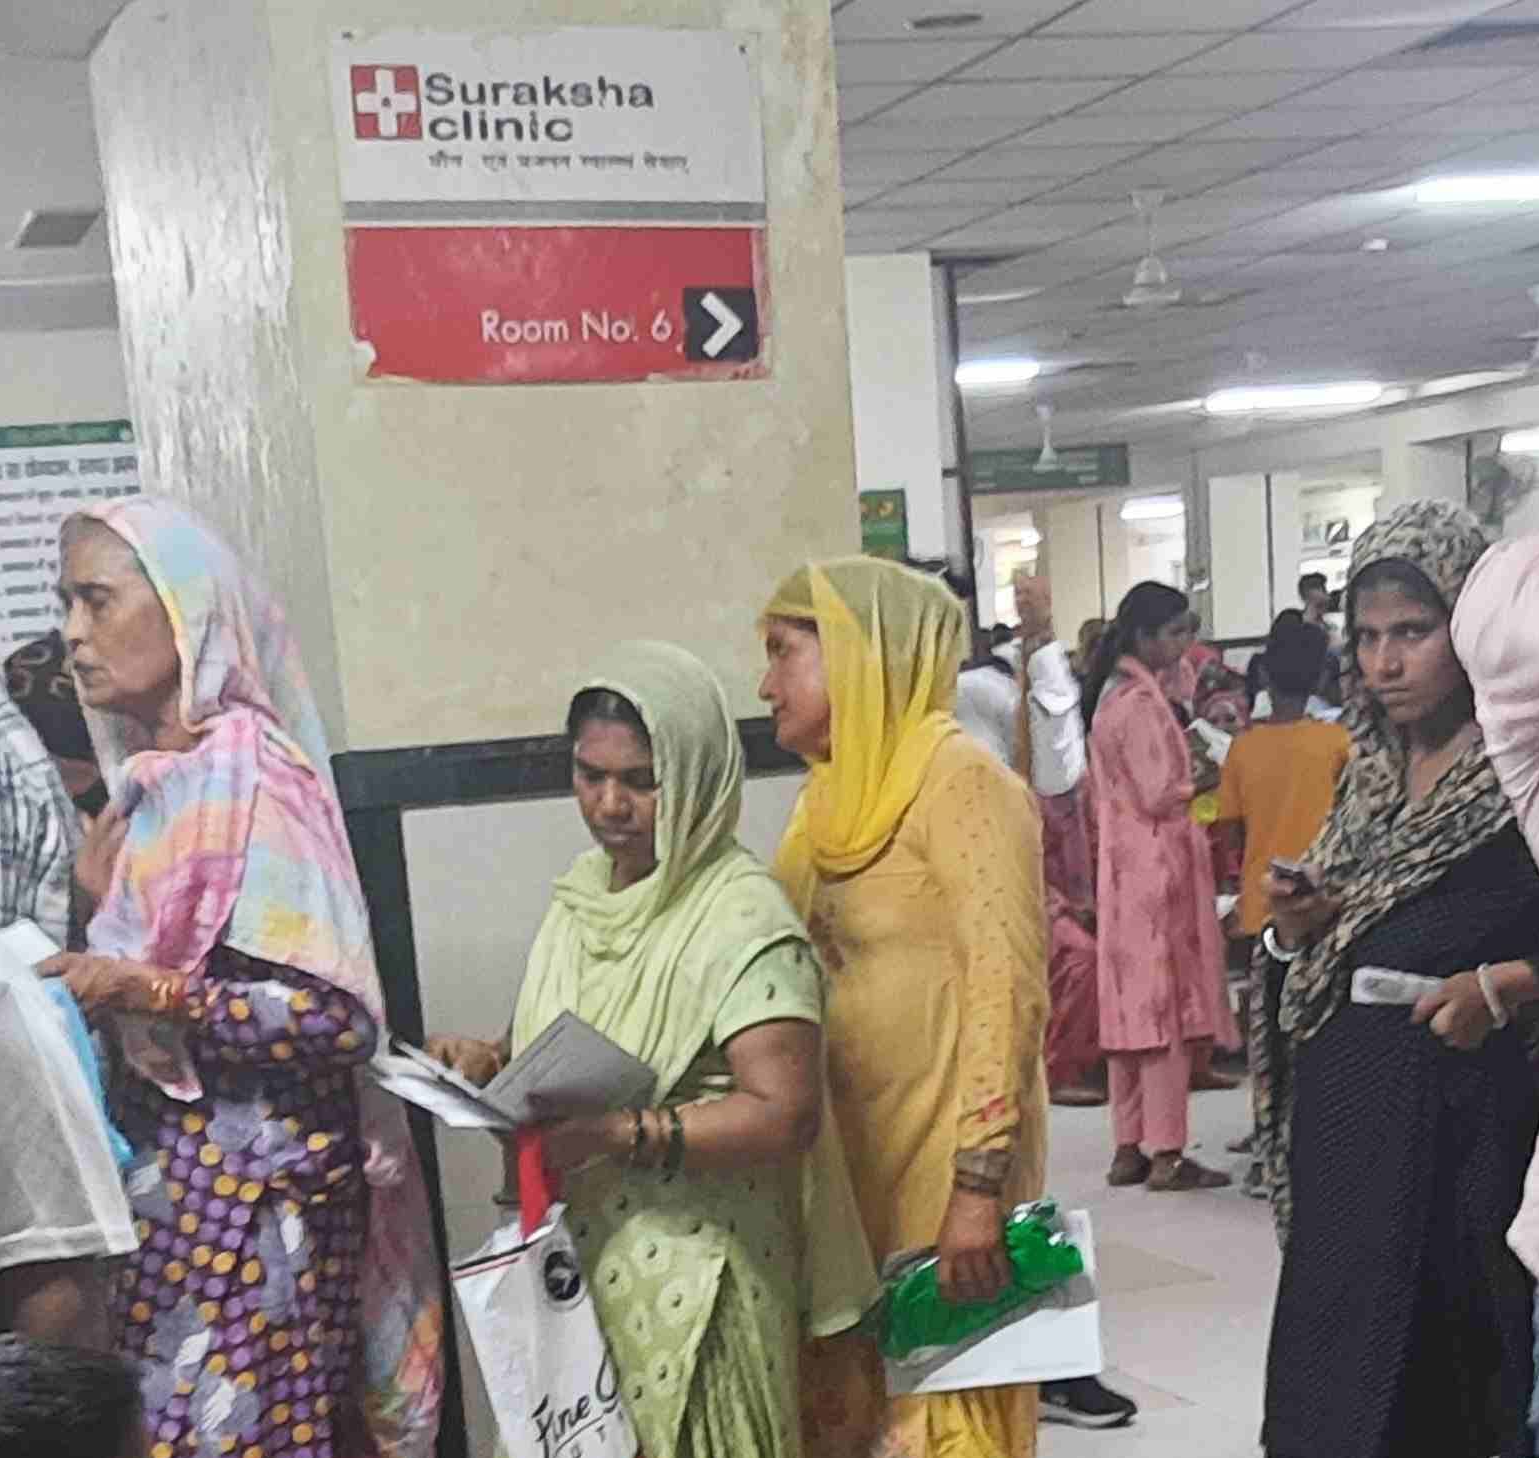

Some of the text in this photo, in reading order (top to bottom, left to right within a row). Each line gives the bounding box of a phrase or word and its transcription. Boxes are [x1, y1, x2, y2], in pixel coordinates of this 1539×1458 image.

[425, 72, 655, 108] Suraksha
[427, 110, 574, 142] clinic
[481, 309, 672, 344] Room No. 6
